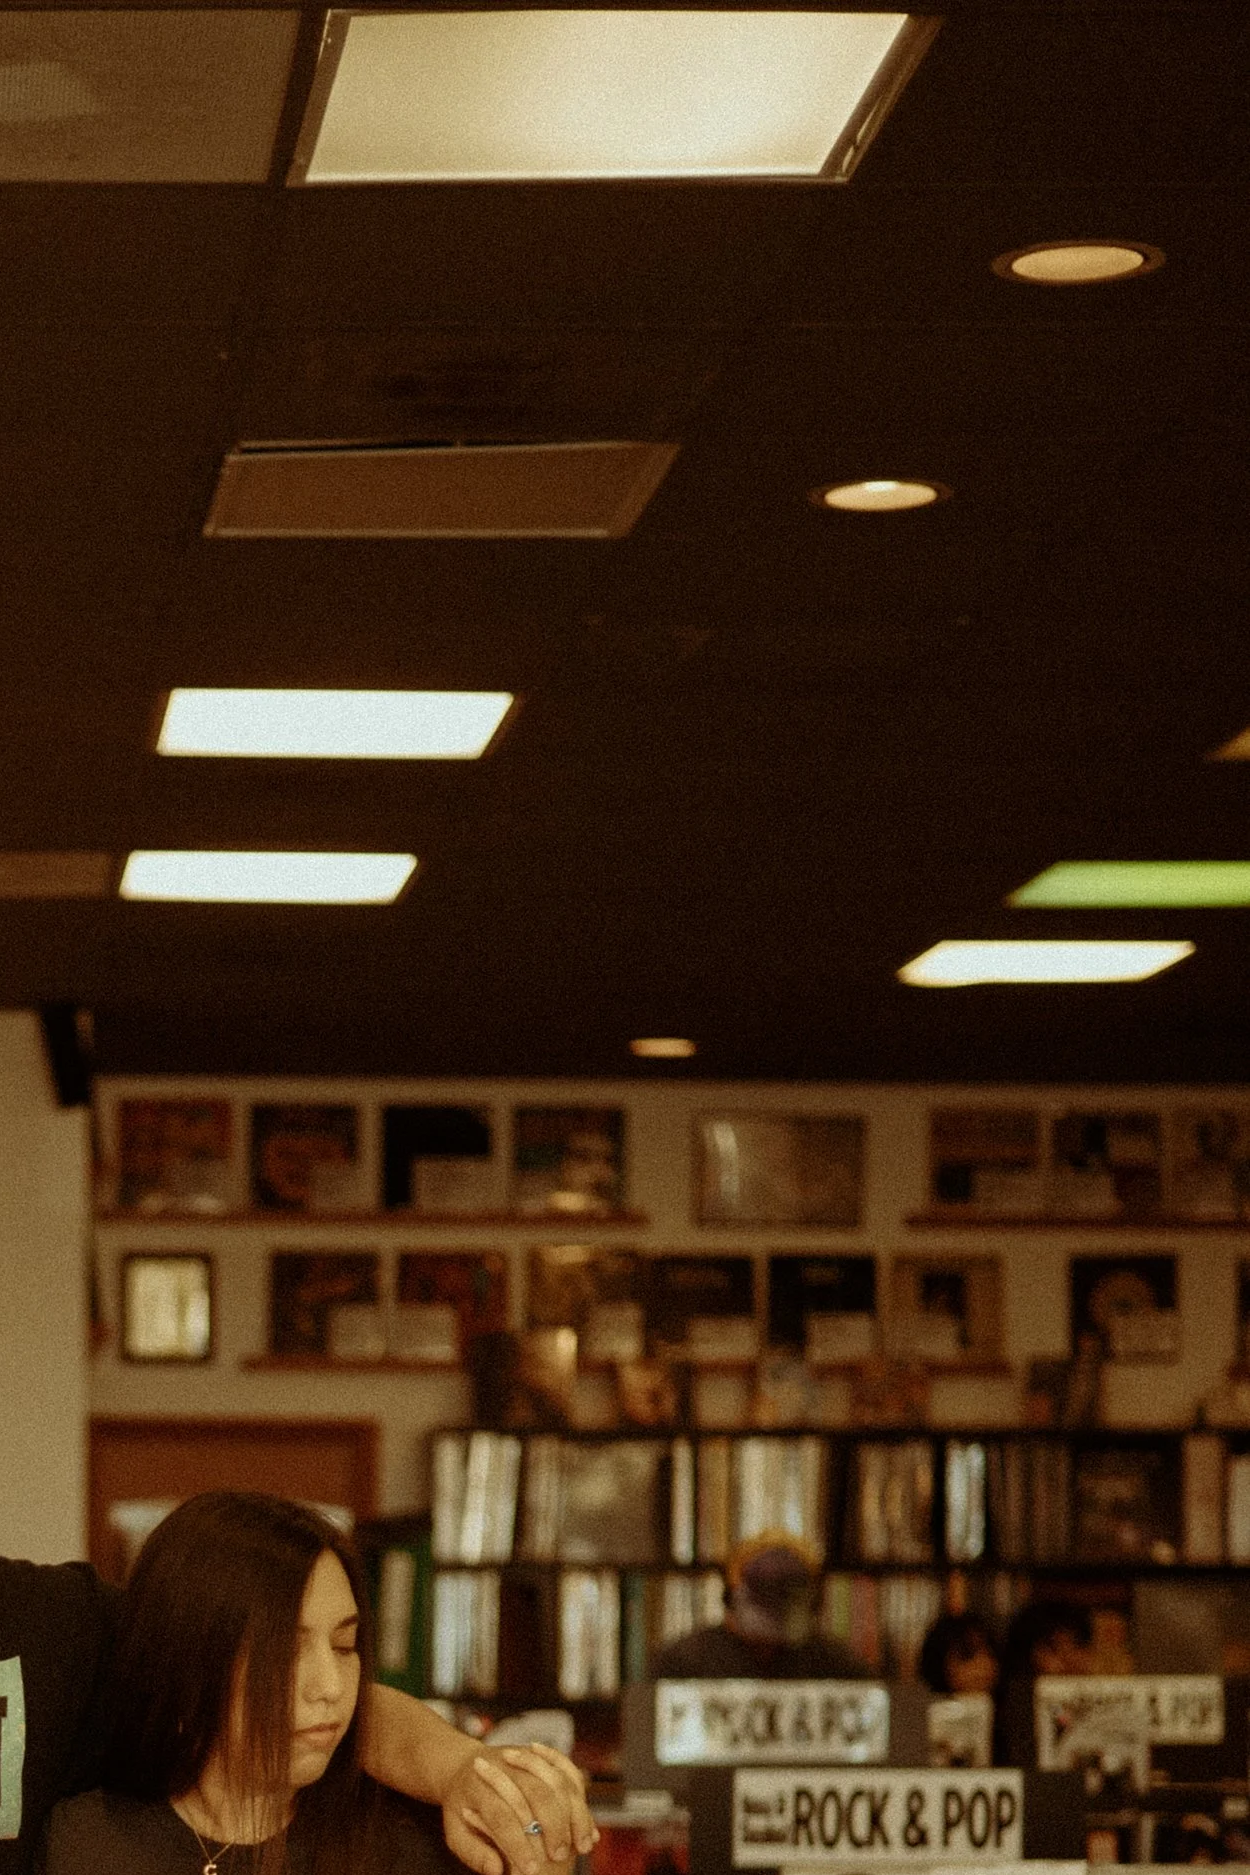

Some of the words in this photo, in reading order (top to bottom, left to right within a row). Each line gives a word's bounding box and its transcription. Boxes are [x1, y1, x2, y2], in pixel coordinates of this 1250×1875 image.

[794, 1788, 889, 1847] ROCK
[904, 1788, 929, 1848] &
[942, 1788, 1016, 1848] POP
